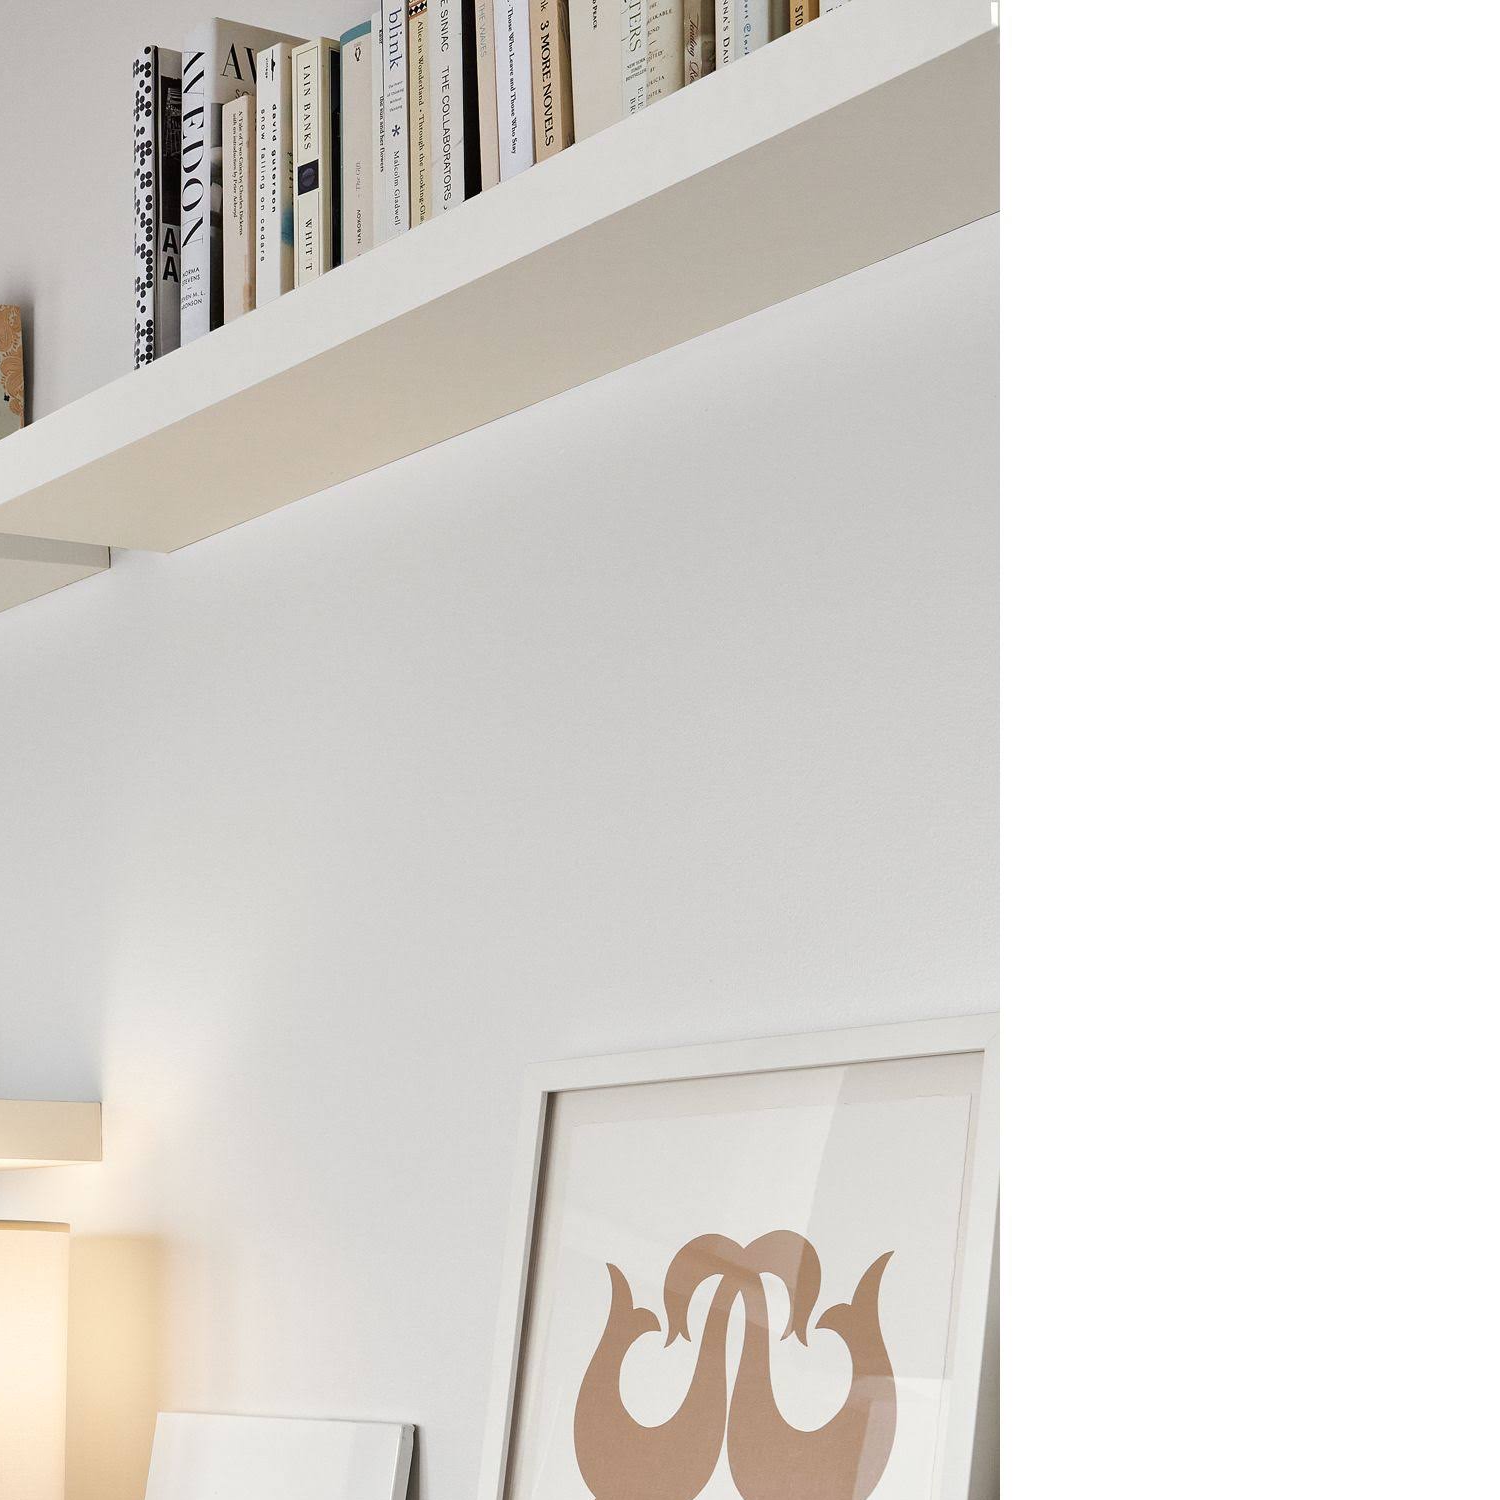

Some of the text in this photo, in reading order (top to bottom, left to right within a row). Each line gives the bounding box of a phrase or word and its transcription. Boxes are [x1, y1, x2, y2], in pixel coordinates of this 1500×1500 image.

[389, 8, 403, 71] blink
[478, 23, 488, 59] WAVES
[540, 20, 550, 32] 3
[417, 55, 425, 107] Wonderland
[541, 33, 553, 83] MORE
[303, 64, 312, 150] IAIN BANKS
[440, 9, 452, 202] SINIAC THE COLLABORATORS
[542, 83, 556, 147] NOVELS
[393, 150, 401, 226] Malcolm Gladwell
